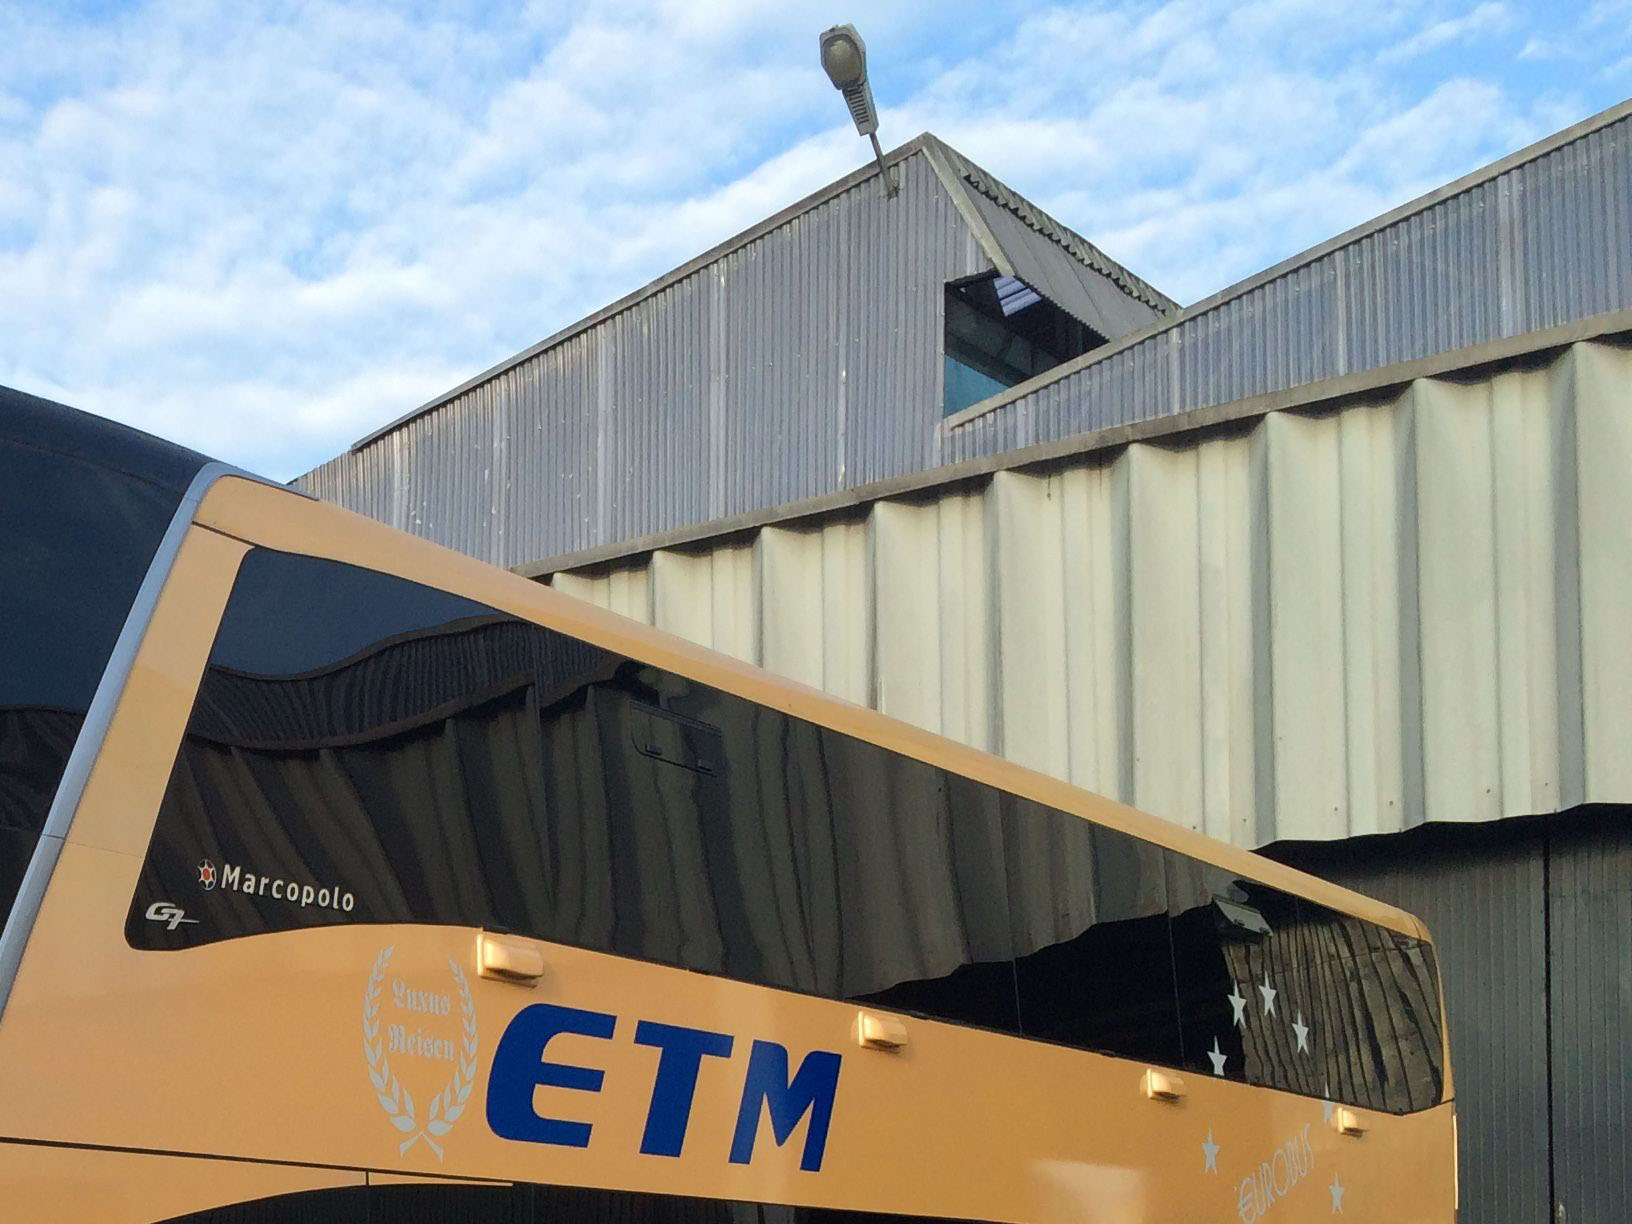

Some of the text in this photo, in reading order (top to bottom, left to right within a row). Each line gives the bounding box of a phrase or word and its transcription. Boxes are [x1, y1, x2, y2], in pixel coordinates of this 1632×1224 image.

[220, 863, 355, 912] Marcopolo
[392, 977, 450, 1017] Luxus
[485, 1002, 844, 1173] ETM
